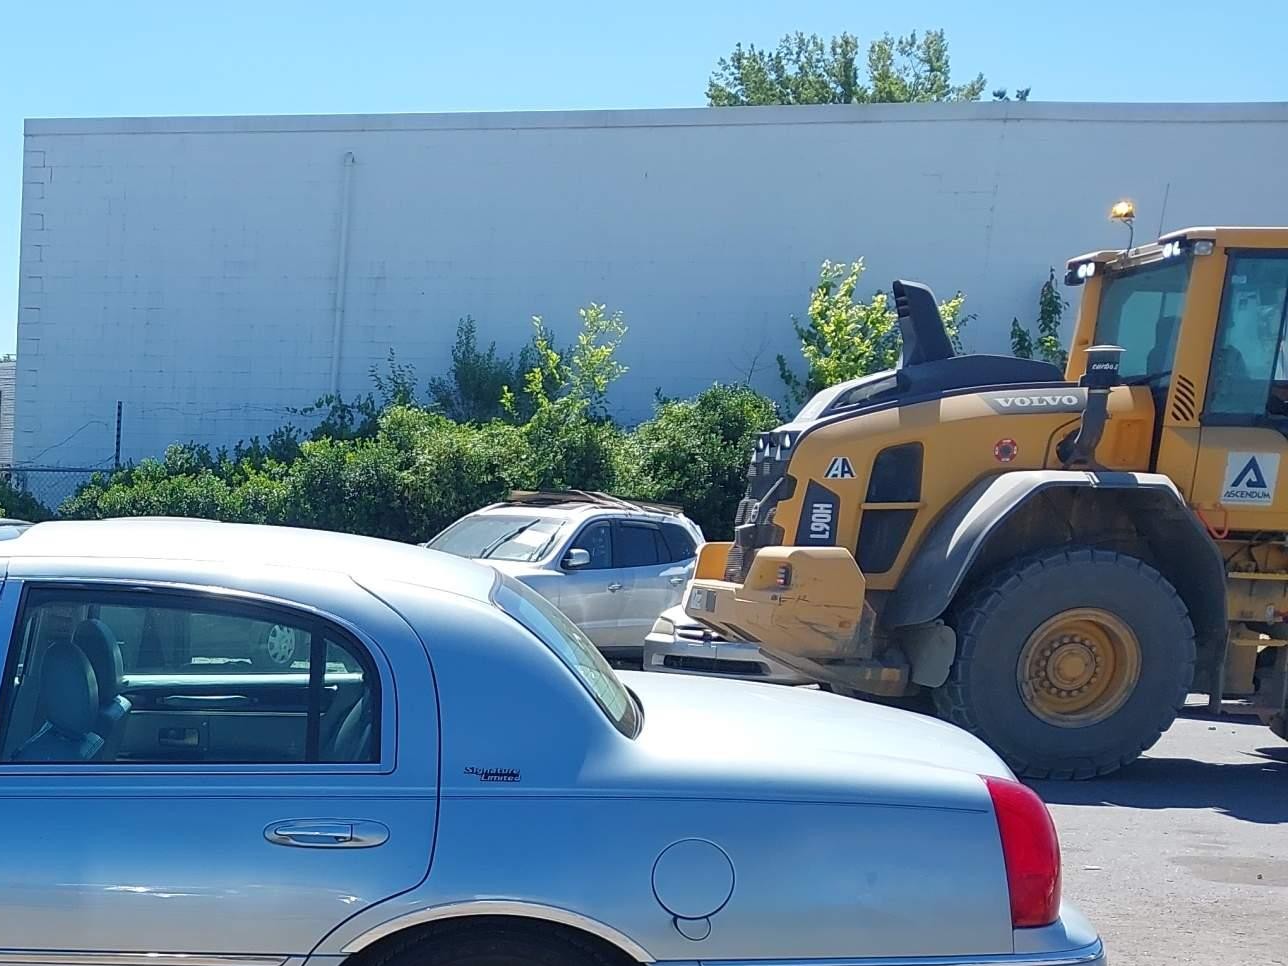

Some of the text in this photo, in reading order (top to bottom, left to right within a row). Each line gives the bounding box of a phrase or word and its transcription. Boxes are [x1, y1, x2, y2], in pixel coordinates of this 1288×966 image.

[994, 395, 1079, 408] VOLVO
[1223, 490, 1271, 499] ASCENDUM
[809, 503, 833, 539] L90H
[480, 774, 521, 782] Limited
